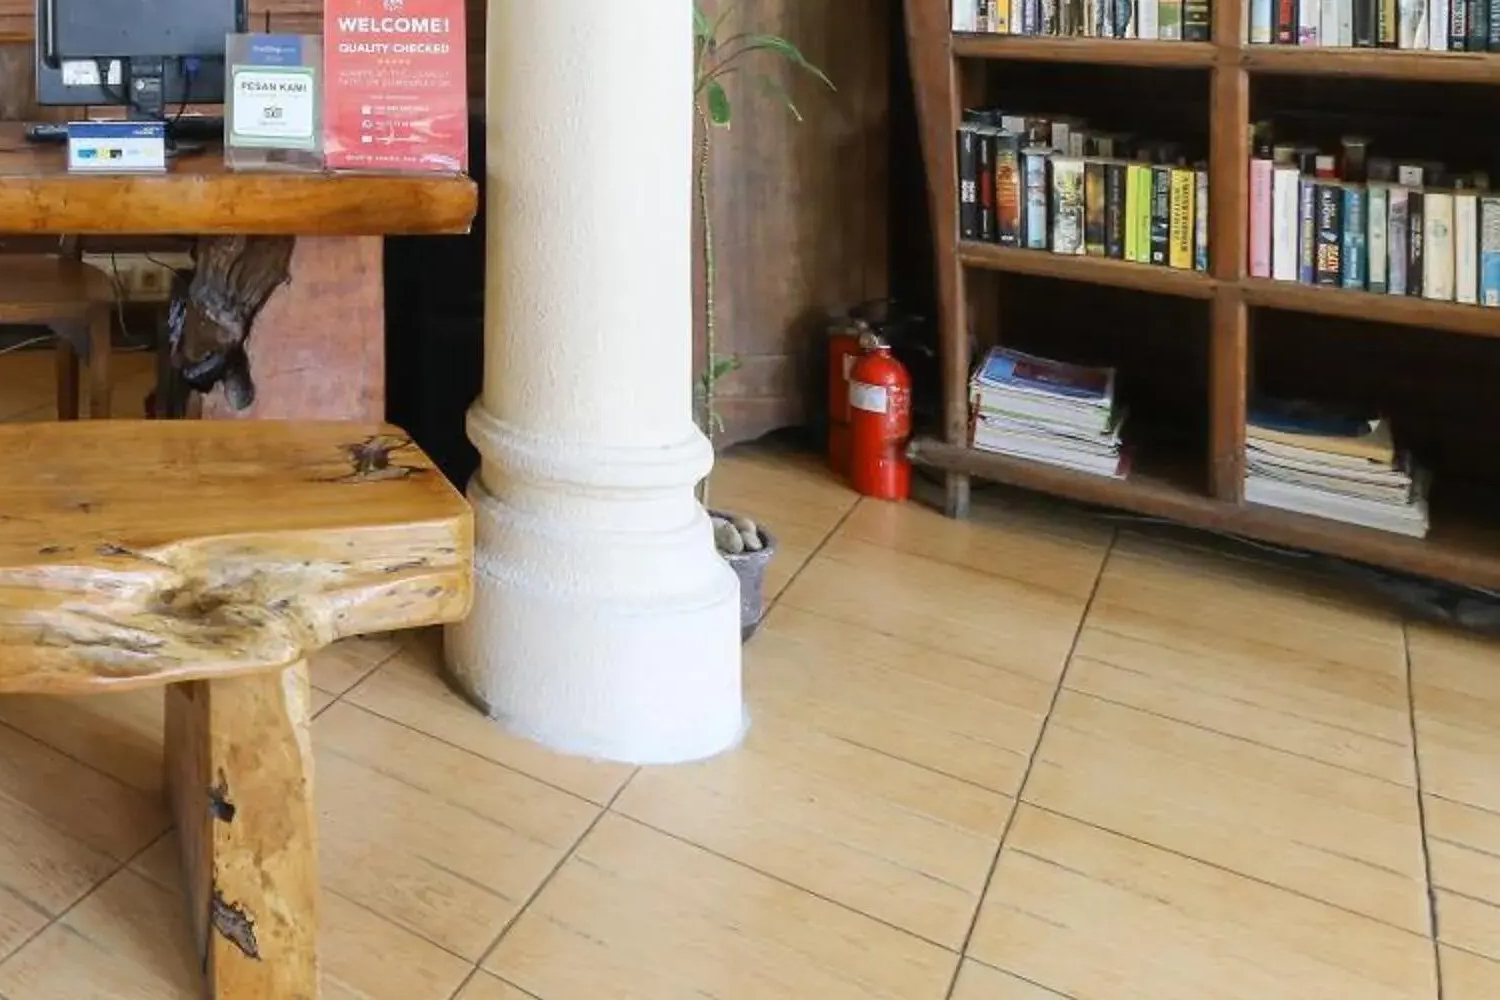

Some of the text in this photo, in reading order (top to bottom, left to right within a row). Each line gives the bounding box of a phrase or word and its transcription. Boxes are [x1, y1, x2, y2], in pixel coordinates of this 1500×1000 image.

[338, 17, 450, 34] WELCOME!
[339, 43, 450, 54] QUALITY CHECKED
